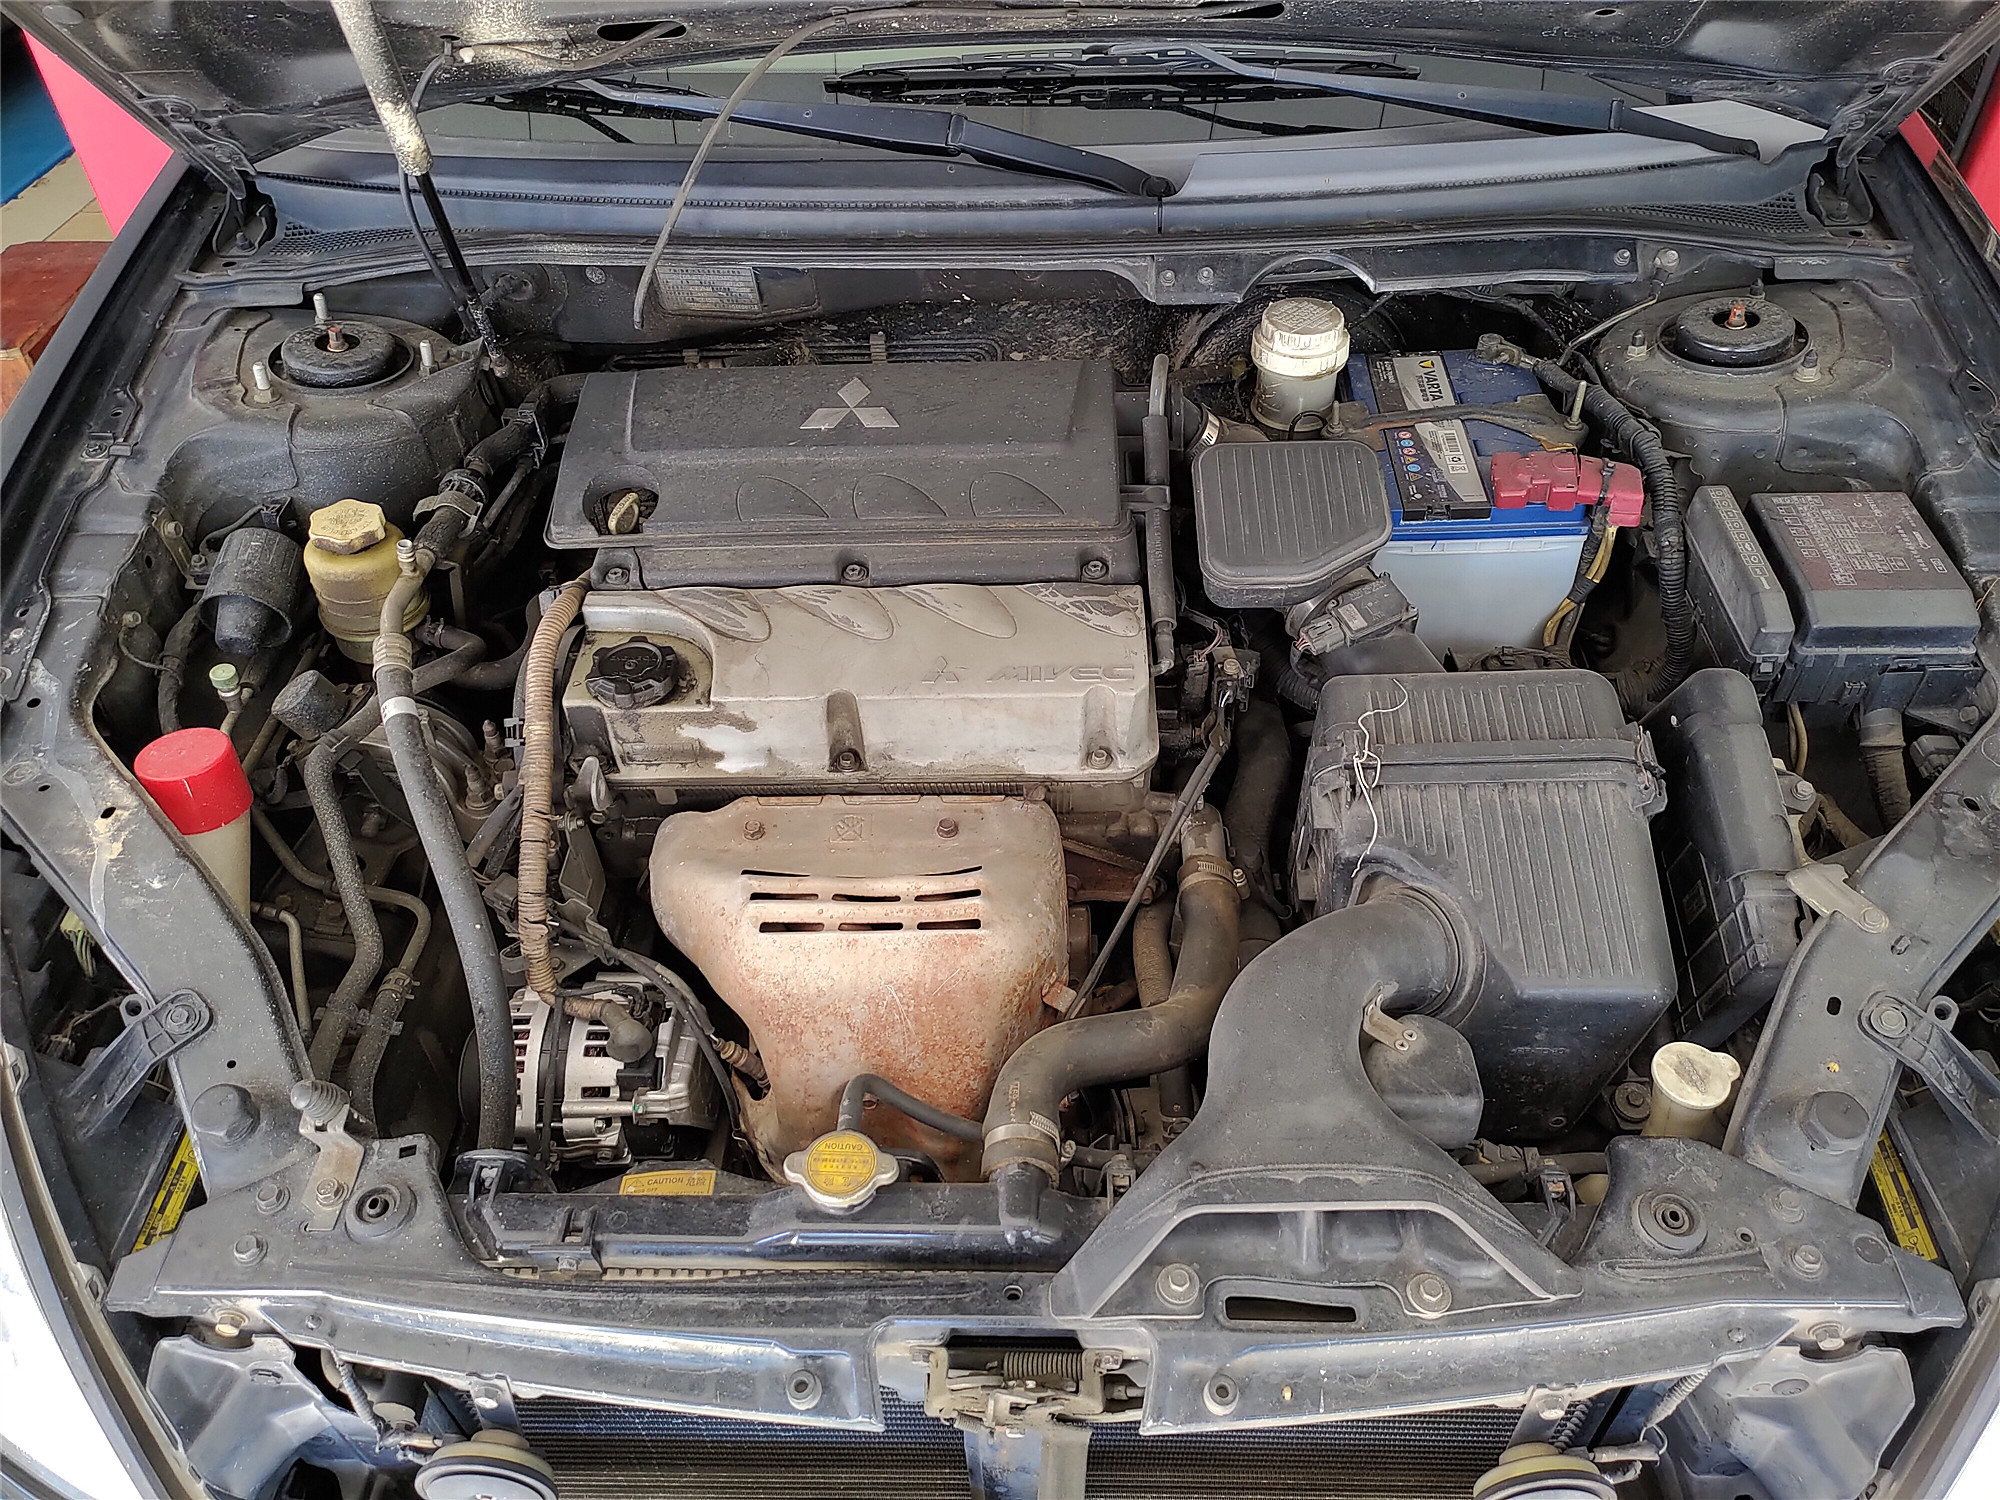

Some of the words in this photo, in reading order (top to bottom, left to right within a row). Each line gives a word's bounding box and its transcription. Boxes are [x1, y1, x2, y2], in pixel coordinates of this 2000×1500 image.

[1423, 370, 1444, 402] VARTA
[985, 665, 1135, 683] MIVEC
[824, 1142, 864, 1151] CAUTION
[647, 1177, 684, 1186] CAUTION
